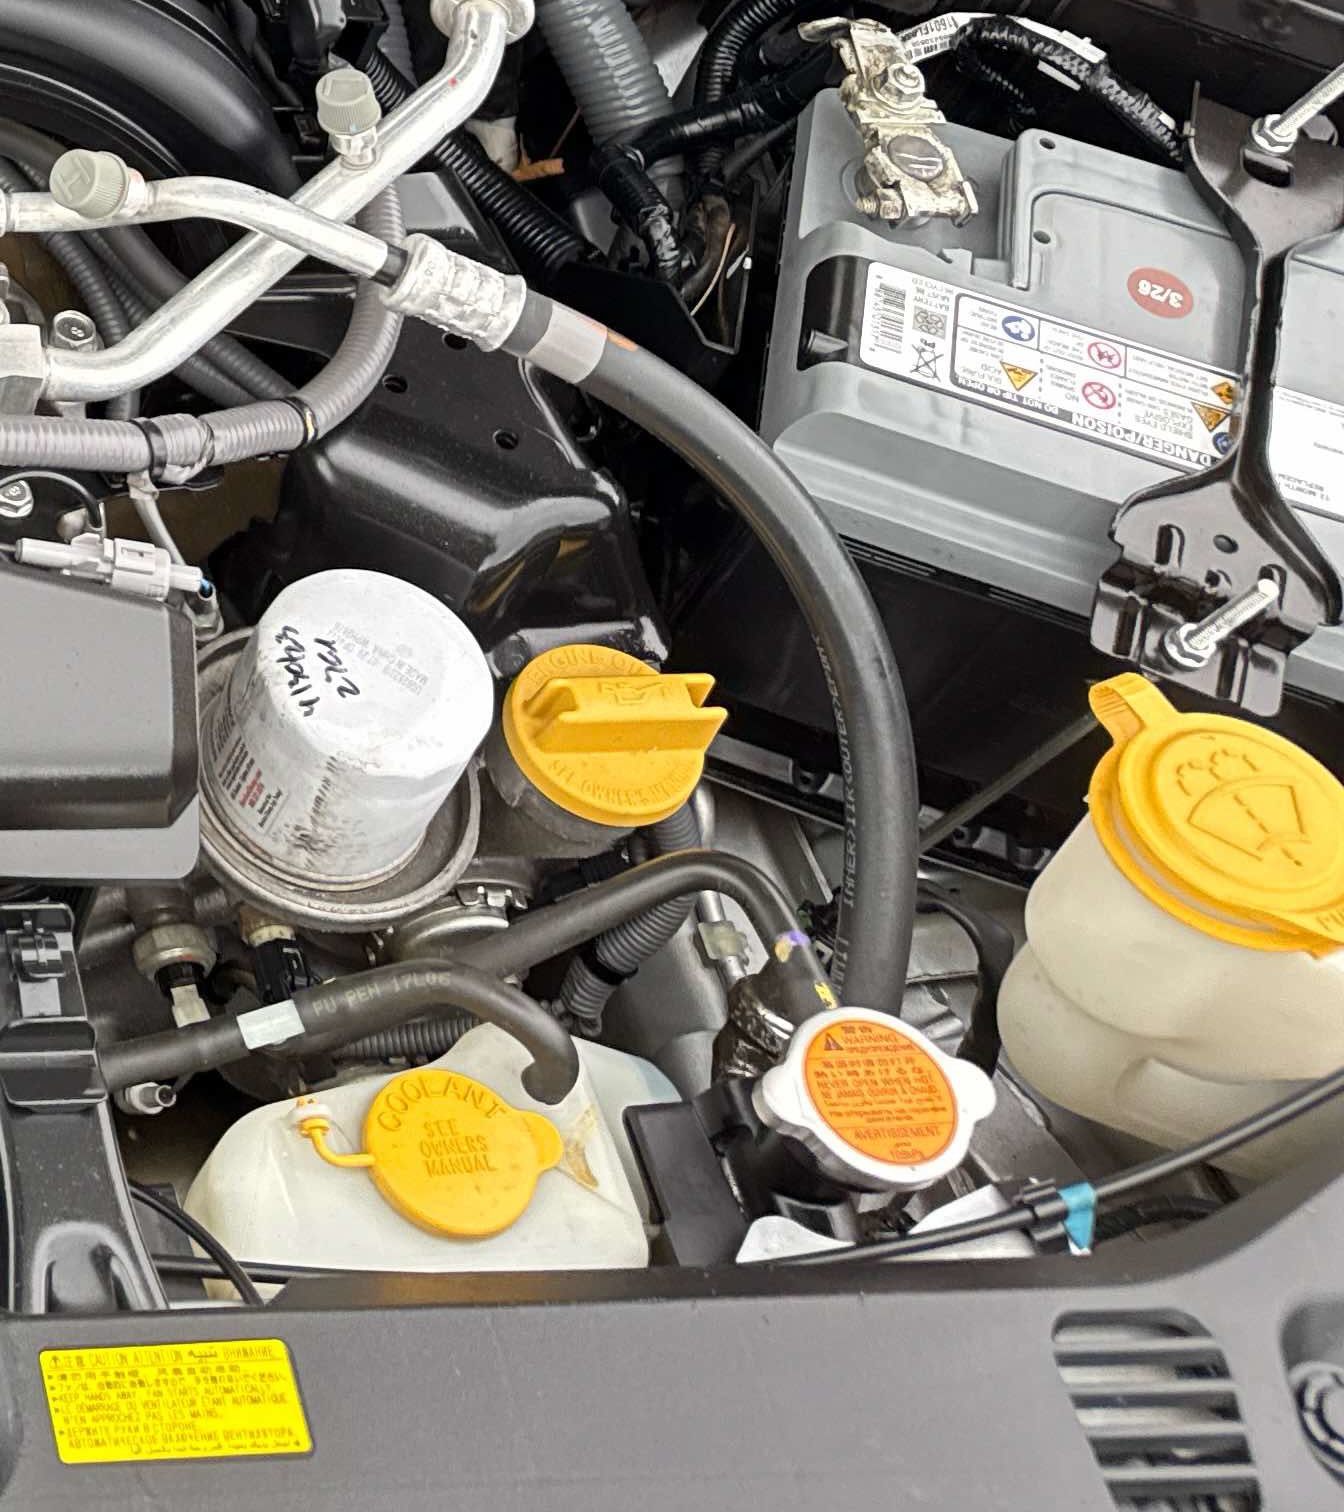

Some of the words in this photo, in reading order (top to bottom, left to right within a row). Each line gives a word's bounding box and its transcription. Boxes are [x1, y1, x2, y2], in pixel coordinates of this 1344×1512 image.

[1071, 411, 1210, 466] DANGER/POISON
[844, 1034, 897, 1044] WARNING
[817, 1079, 848, 1088] NEVER
[852, 1079, 878, 1087] OPEN
[377, 1076, 507, 1132] COOLANT
[423, 1119, 459, 1137] SEE
[854, 1126, 940, 1139] AVERTISSEMENT
[423, 1154, 499, 1178] MANUAL
[88, 1351, 129, 1367] CAUTION
[132, 1348, 183, 1364] ATTENTION
